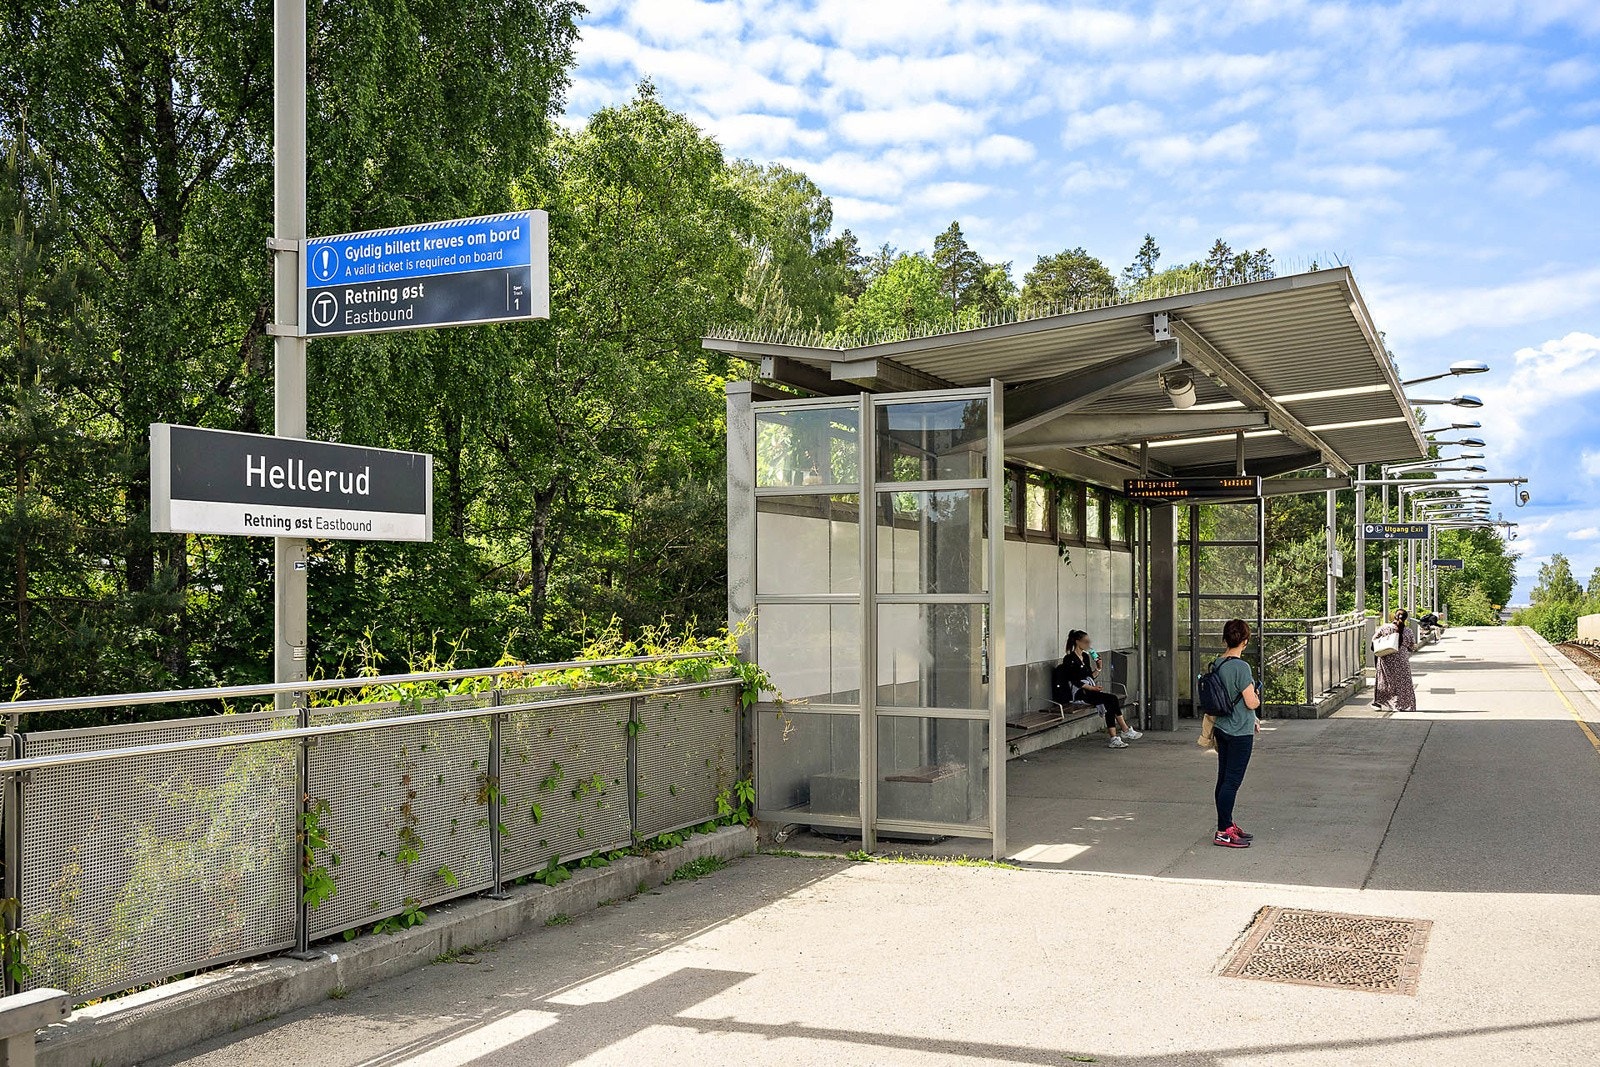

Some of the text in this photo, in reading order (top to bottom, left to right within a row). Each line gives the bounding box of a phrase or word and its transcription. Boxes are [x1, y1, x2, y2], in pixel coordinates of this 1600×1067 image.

[345, 227, 519, 262] Gyldig billett kreves om bord
[345, 249, 502, 276] A valid ticket is required on board
[346, 283, 424, 304] Retning øst
[514, 298, 519, 310] 1
[346, 306, 413, 324] Eastbound
[246, 454, 370, 495] Hellerud
[244, 514, 372, 531] Retning øst Eastbound
